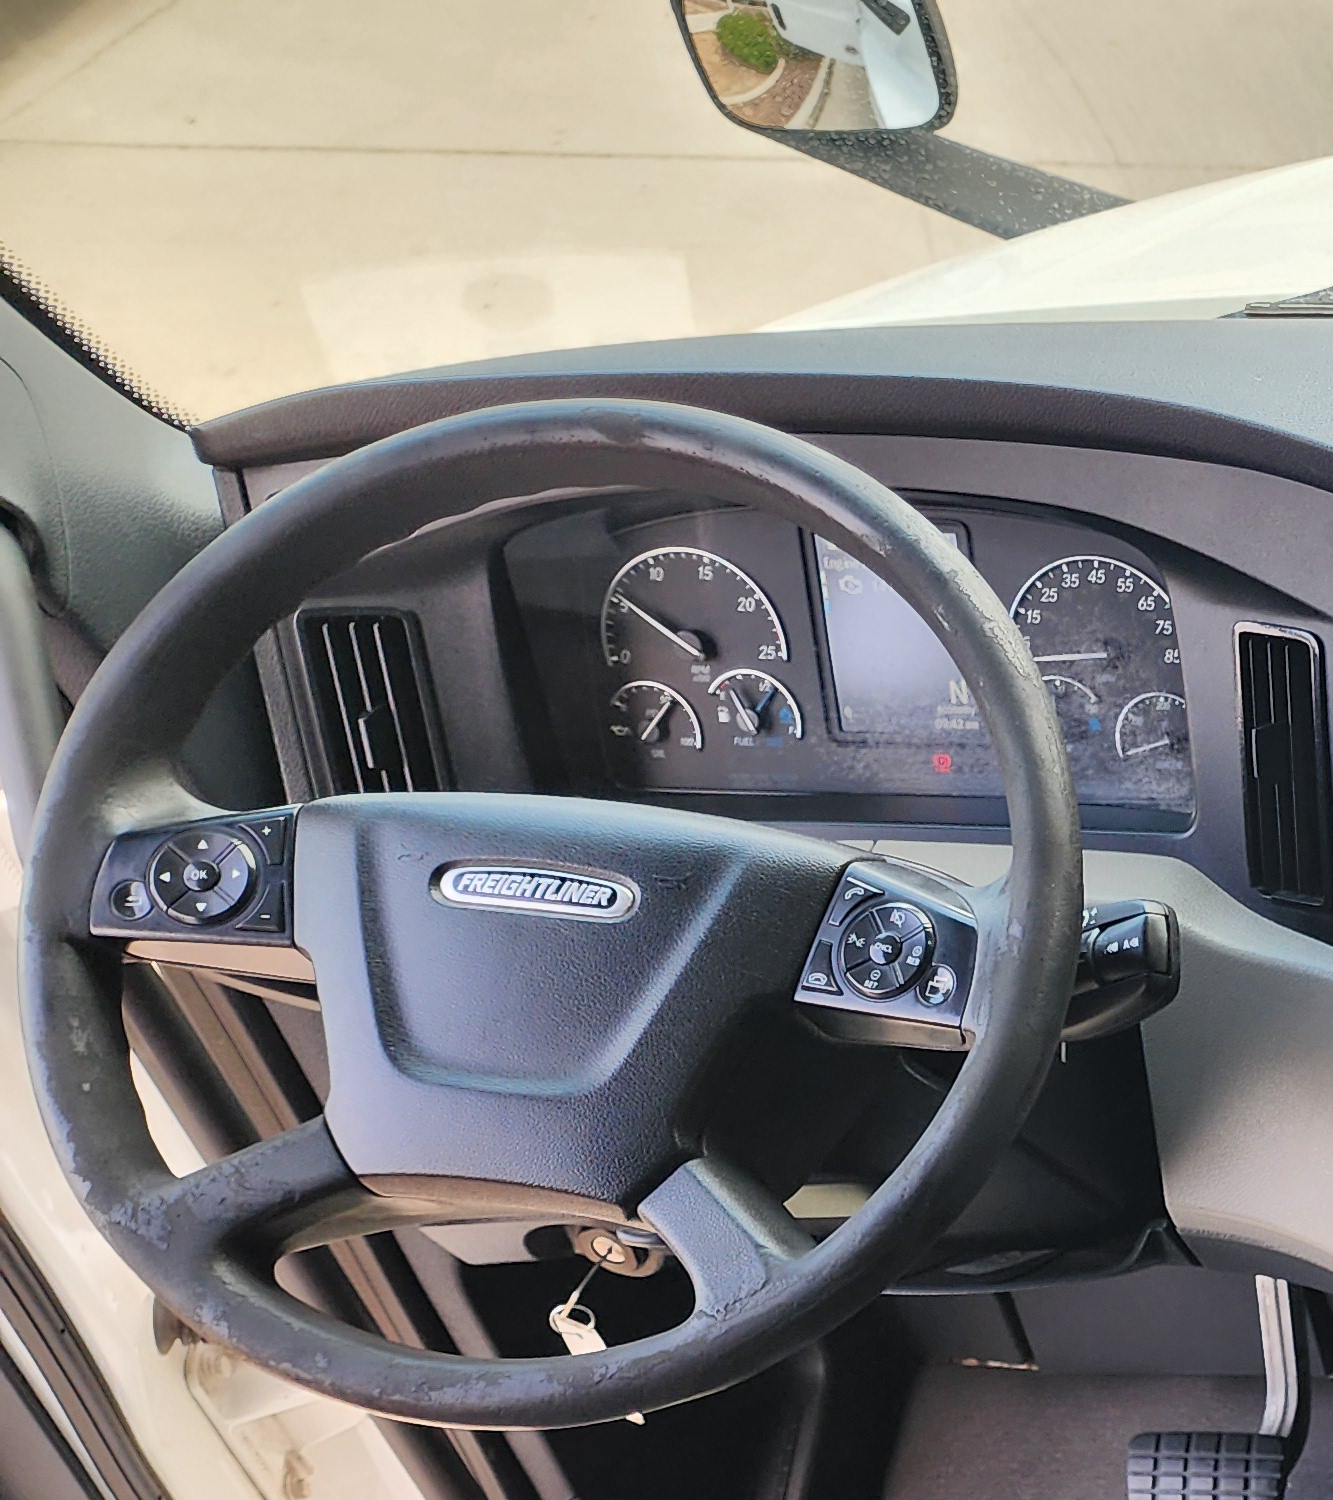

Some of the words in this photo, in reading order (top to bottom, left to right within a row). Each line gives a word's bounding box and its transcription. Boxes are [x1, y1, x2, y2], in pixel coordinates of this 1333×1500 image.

[649, 567, 664, 582] 10
[698, 566, 713, 581] 15
[1061, 573, 1080, 588] 35
[1087, 569, 1106, 584] 45
[1116, 578, 1134, 592] 55
[1040, 587, 1058, 602] 25
[737, 597, 755, 612] 20
[1137, 596, 1156, 611] 65
[1026, 609, 1041, 624] 15
[1155, 620, 1173, 635] 75
[757, 645, 776, 660] 25
[190, 869, 208, 881] OK
[457, 873, 613, 907] FREIGHTLINER
